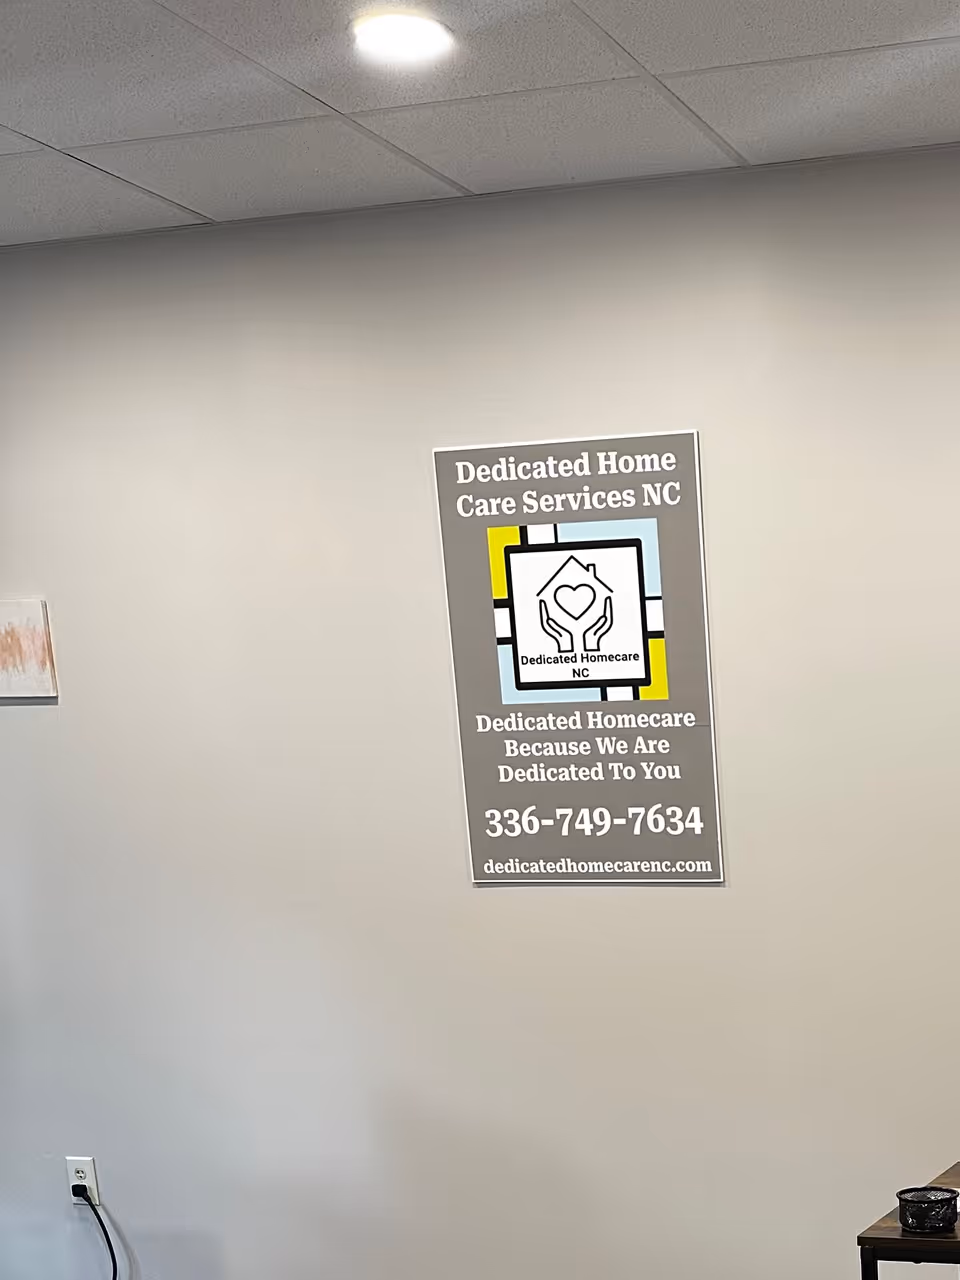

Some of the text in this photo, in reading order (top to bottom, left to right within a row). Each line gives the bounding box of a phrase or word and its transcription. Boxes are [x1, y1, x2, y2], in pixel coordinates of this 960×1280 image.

[456, 452, 676, 483] Dedicated Home
[457, 482, 680, 517] Care Services NC
[521, 650, 639, 665] Dedicated Homecare
[573, 668, 589, 678] NC
[476, 712, 695, 732] Dedicated Homecare
[504, 736, 669, 756] Because We Are
[498, 762, 681, 782] Dedicated To You
[485, 804, 703, 837] 336-749-7634
[484, 859, 712, 873] dedicatedhomecarenc.com
